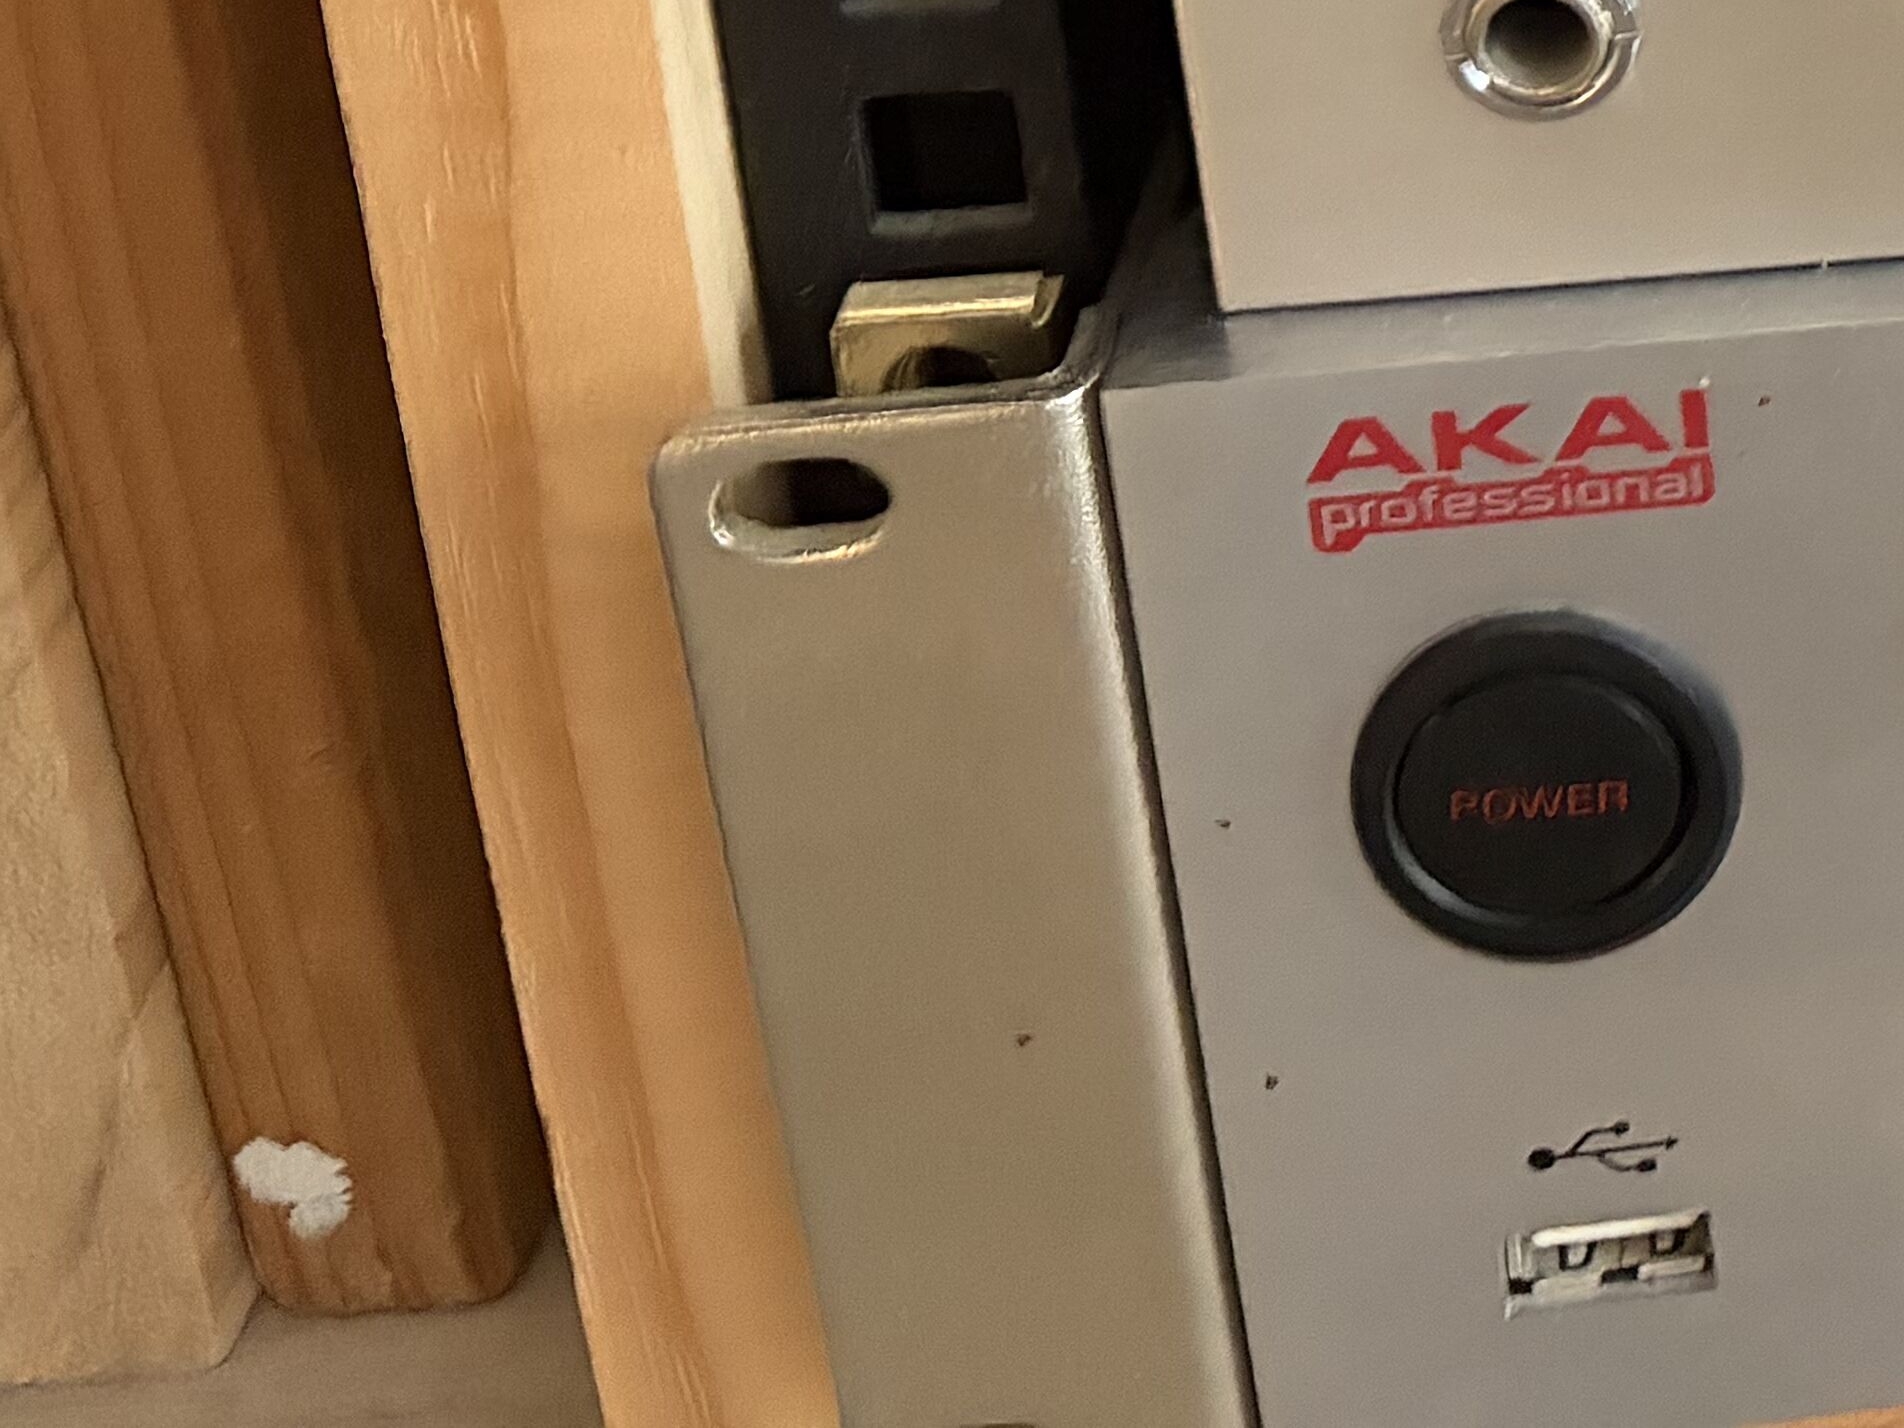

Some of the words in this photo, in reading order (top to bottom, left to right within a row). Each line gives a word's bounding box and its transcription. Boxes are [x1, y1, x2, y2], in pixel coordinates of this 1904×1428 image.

[1306, 388, 1710, 482] AKAI
[1320, 466, 1706, 544] professional
[1448, 780, 1630, 822] POWER
